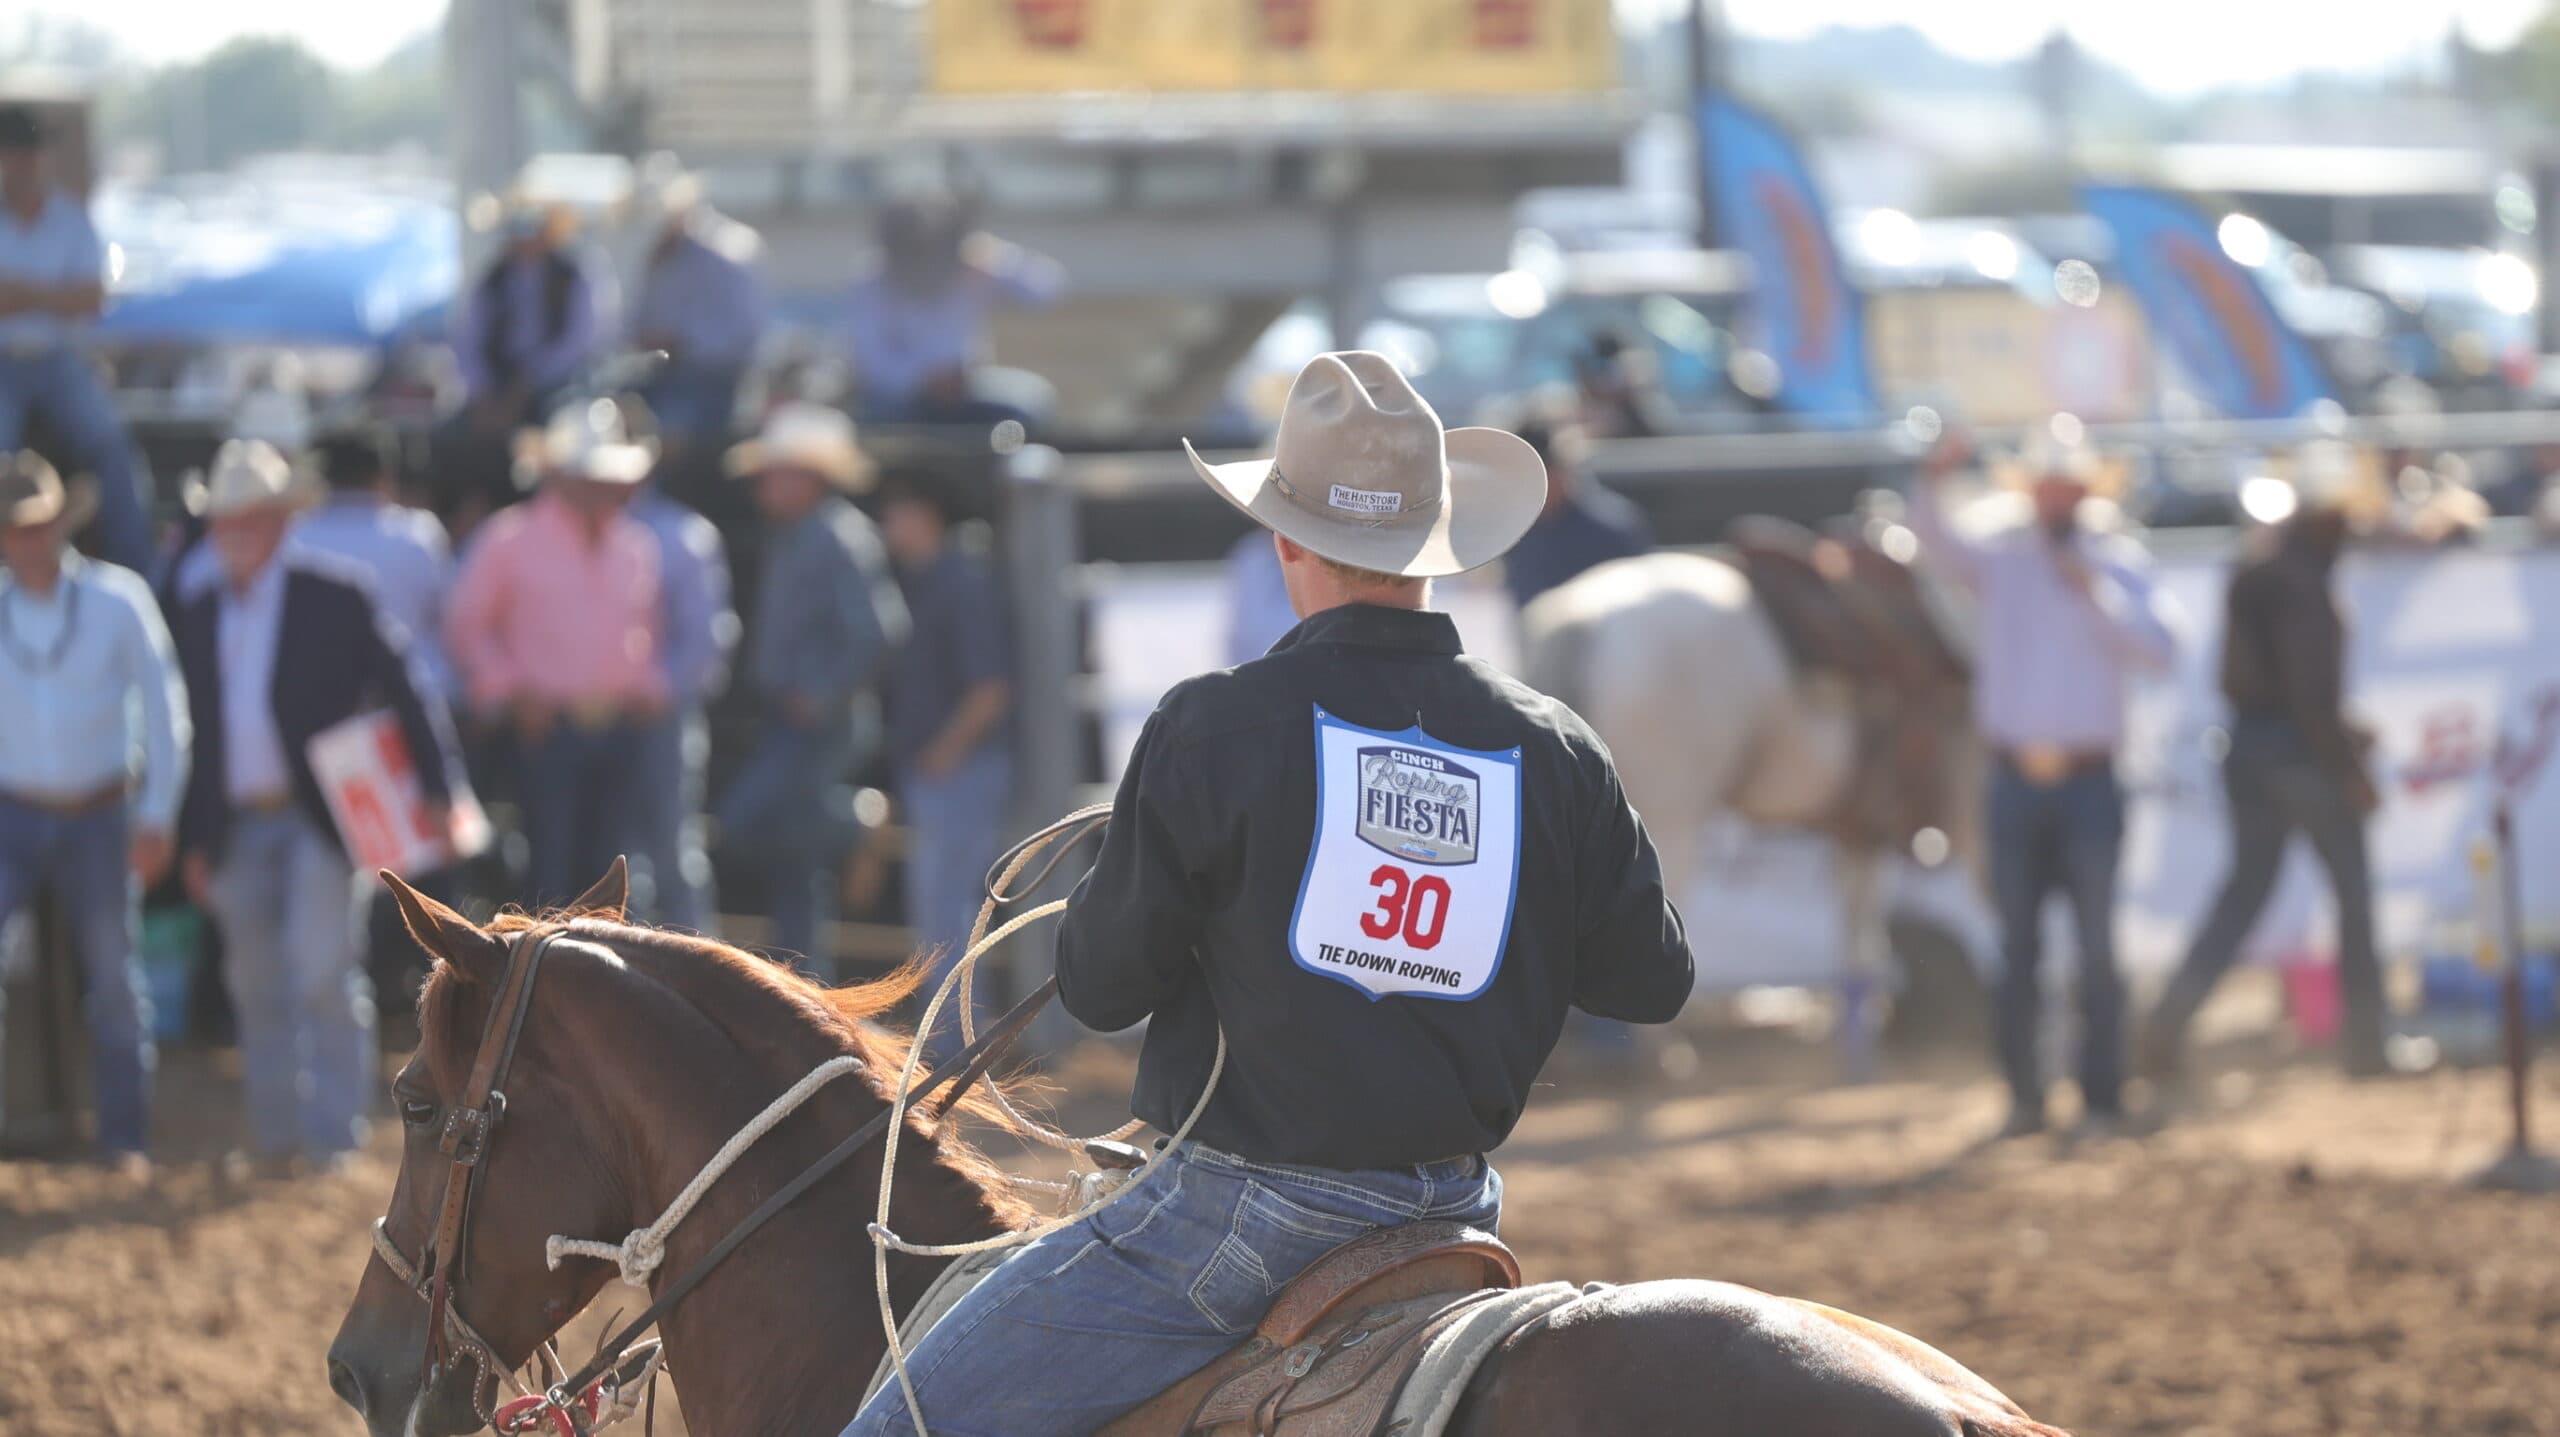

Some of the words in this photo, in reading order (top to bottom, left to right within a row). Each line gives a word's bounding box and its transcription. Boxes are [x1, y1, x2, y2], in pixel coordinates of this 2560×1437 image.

[1333, 486, 1351, 501] THE
[1351, 492, 1369, 503] HAT
[1369, 494, 1399, 505] STORE
[1373, 504, 1393, 512] TEXAS
[1364, 755, 1471, 806] Roping
[1390, 750, 1445, 771] CINCH
[1366, 787, 1472, 846] FIESTA
[1360, 864, 1451, 950] 30
[1318, 943, 1345, 963] TIE
[1344, 949, 1397, 974] DOWN
[1397, 960, 1462, 989] ROPING
